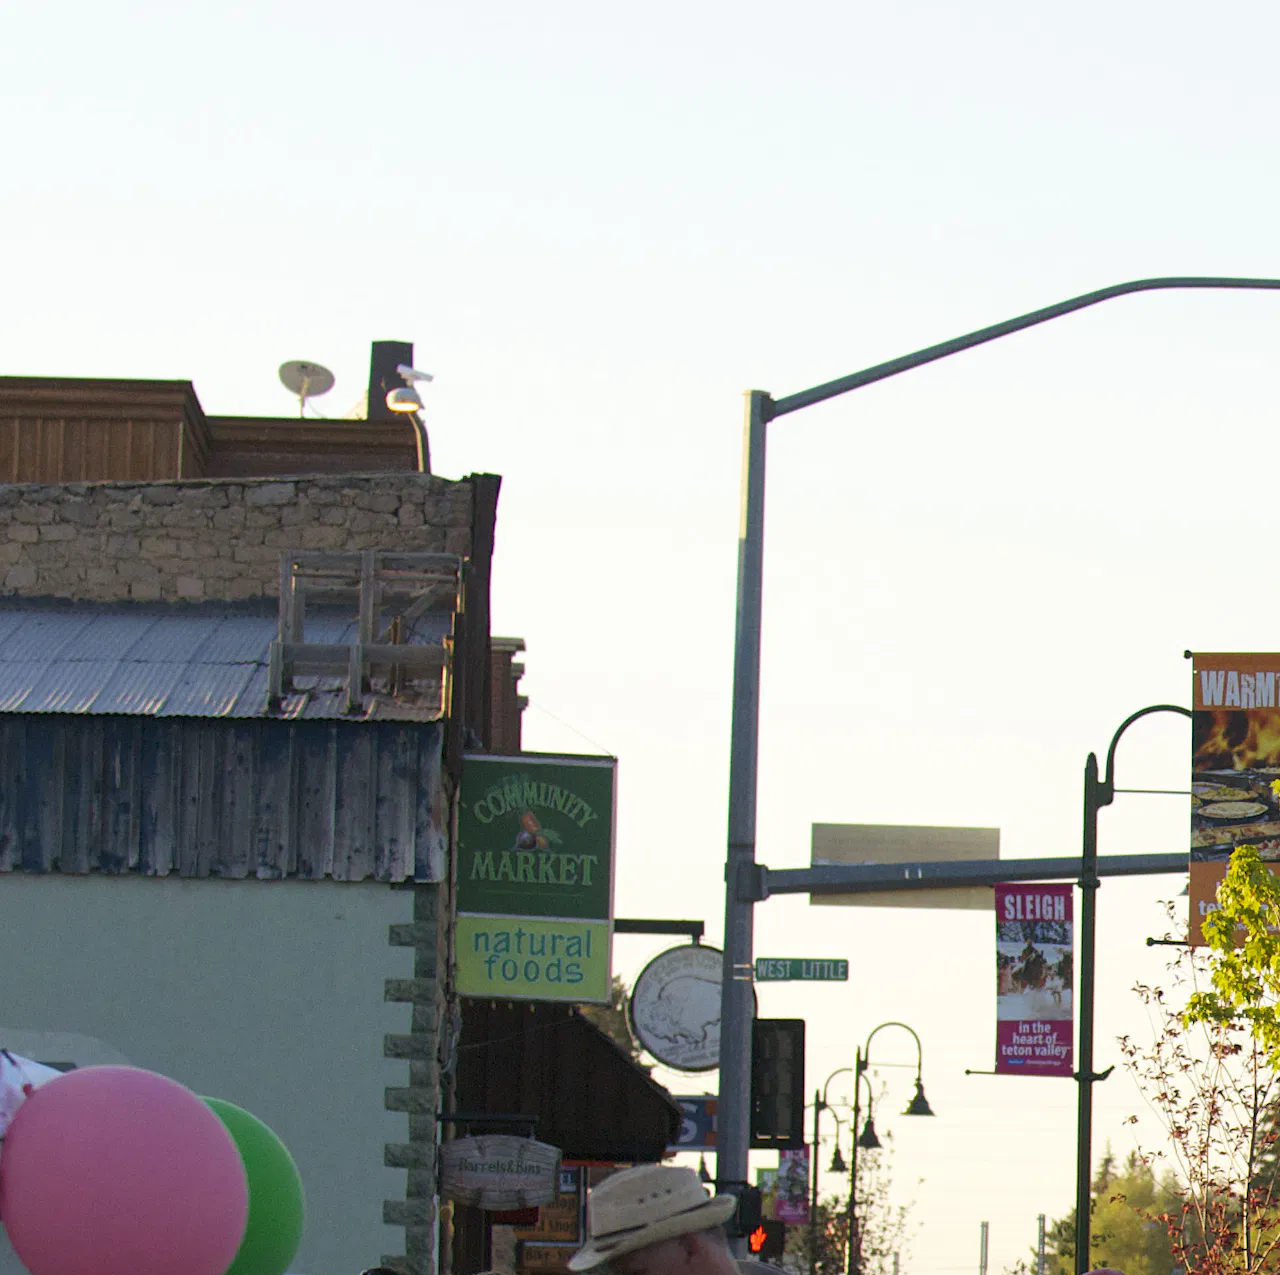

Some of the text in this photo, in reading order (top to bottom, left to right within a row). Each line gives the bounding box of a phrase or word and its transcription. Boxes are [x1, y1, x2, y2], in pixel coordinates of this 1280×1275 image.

[472, 780, 599, 829] COMMUNITY
[468, 851, 599, 886] MARKET
[1004, 894, 1066, 921] SLEIGH
[472, 927, 592, 959] natural
[483, 954, 585, 985] foods
[757, 960, 847, 980] WEST LITTLE
[1012, 1032, 1059, 1045] heart of
[1018, 1021, 1052, 1034] in the
[1001, 1043, 1068, 1059] teton valley
